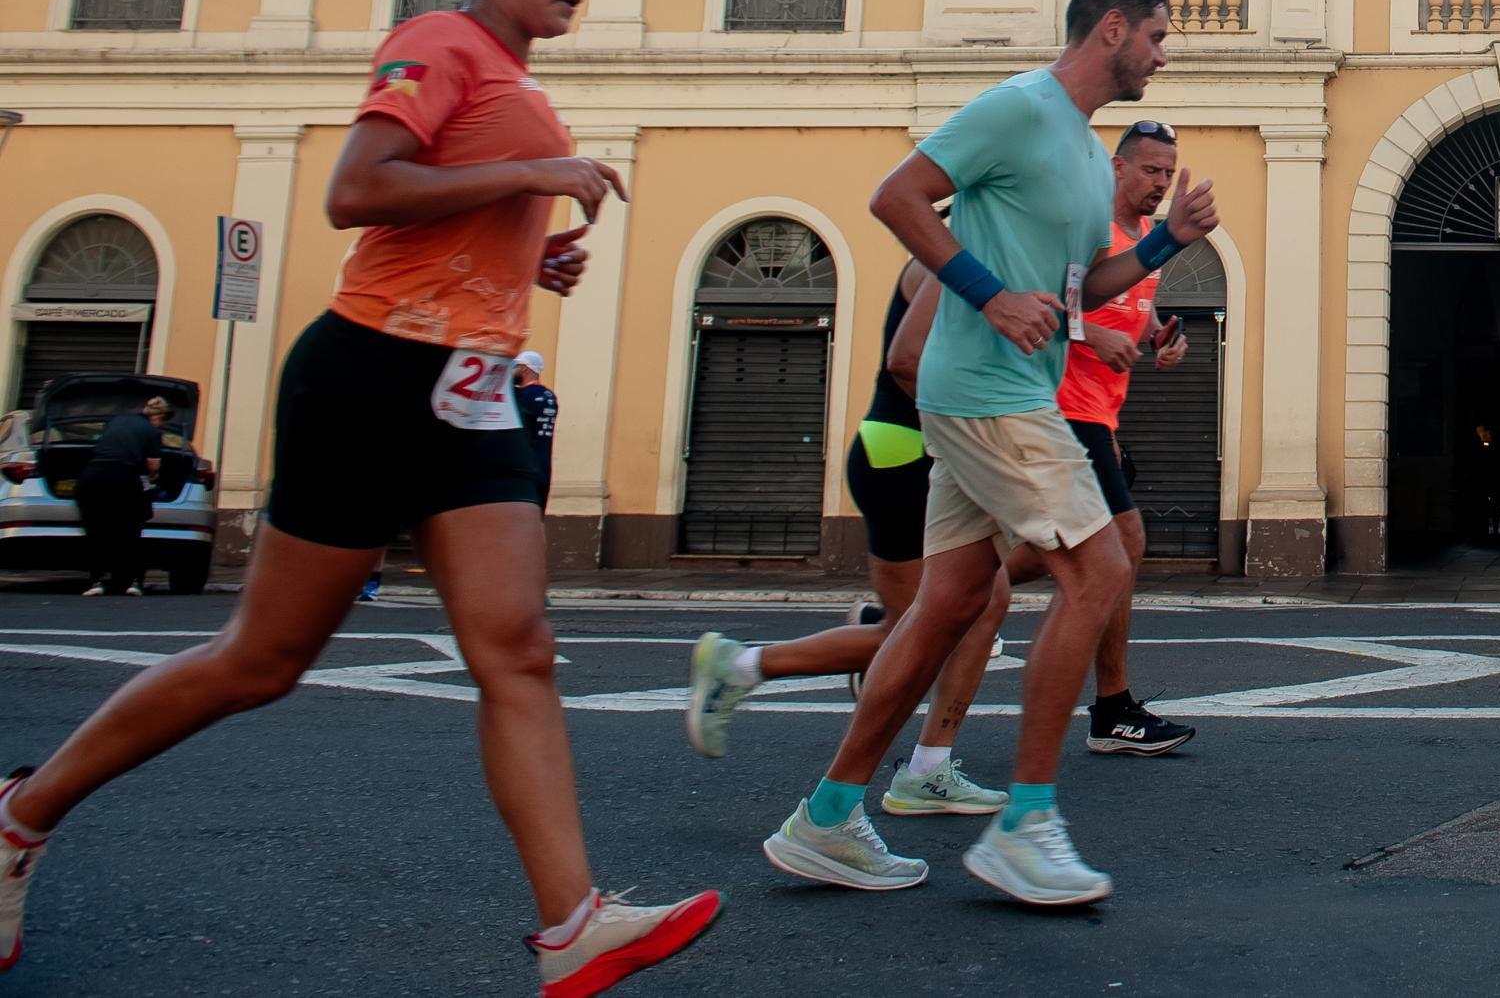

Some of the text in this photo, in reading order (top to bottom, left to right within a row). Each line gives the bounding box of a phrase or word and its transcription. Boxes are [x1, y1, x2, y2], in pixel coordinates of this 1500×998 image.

[237, 229, 249, 253] E
[1111, 723, 1146, 740] FILA
[920, 781, 948, 798] FILA
